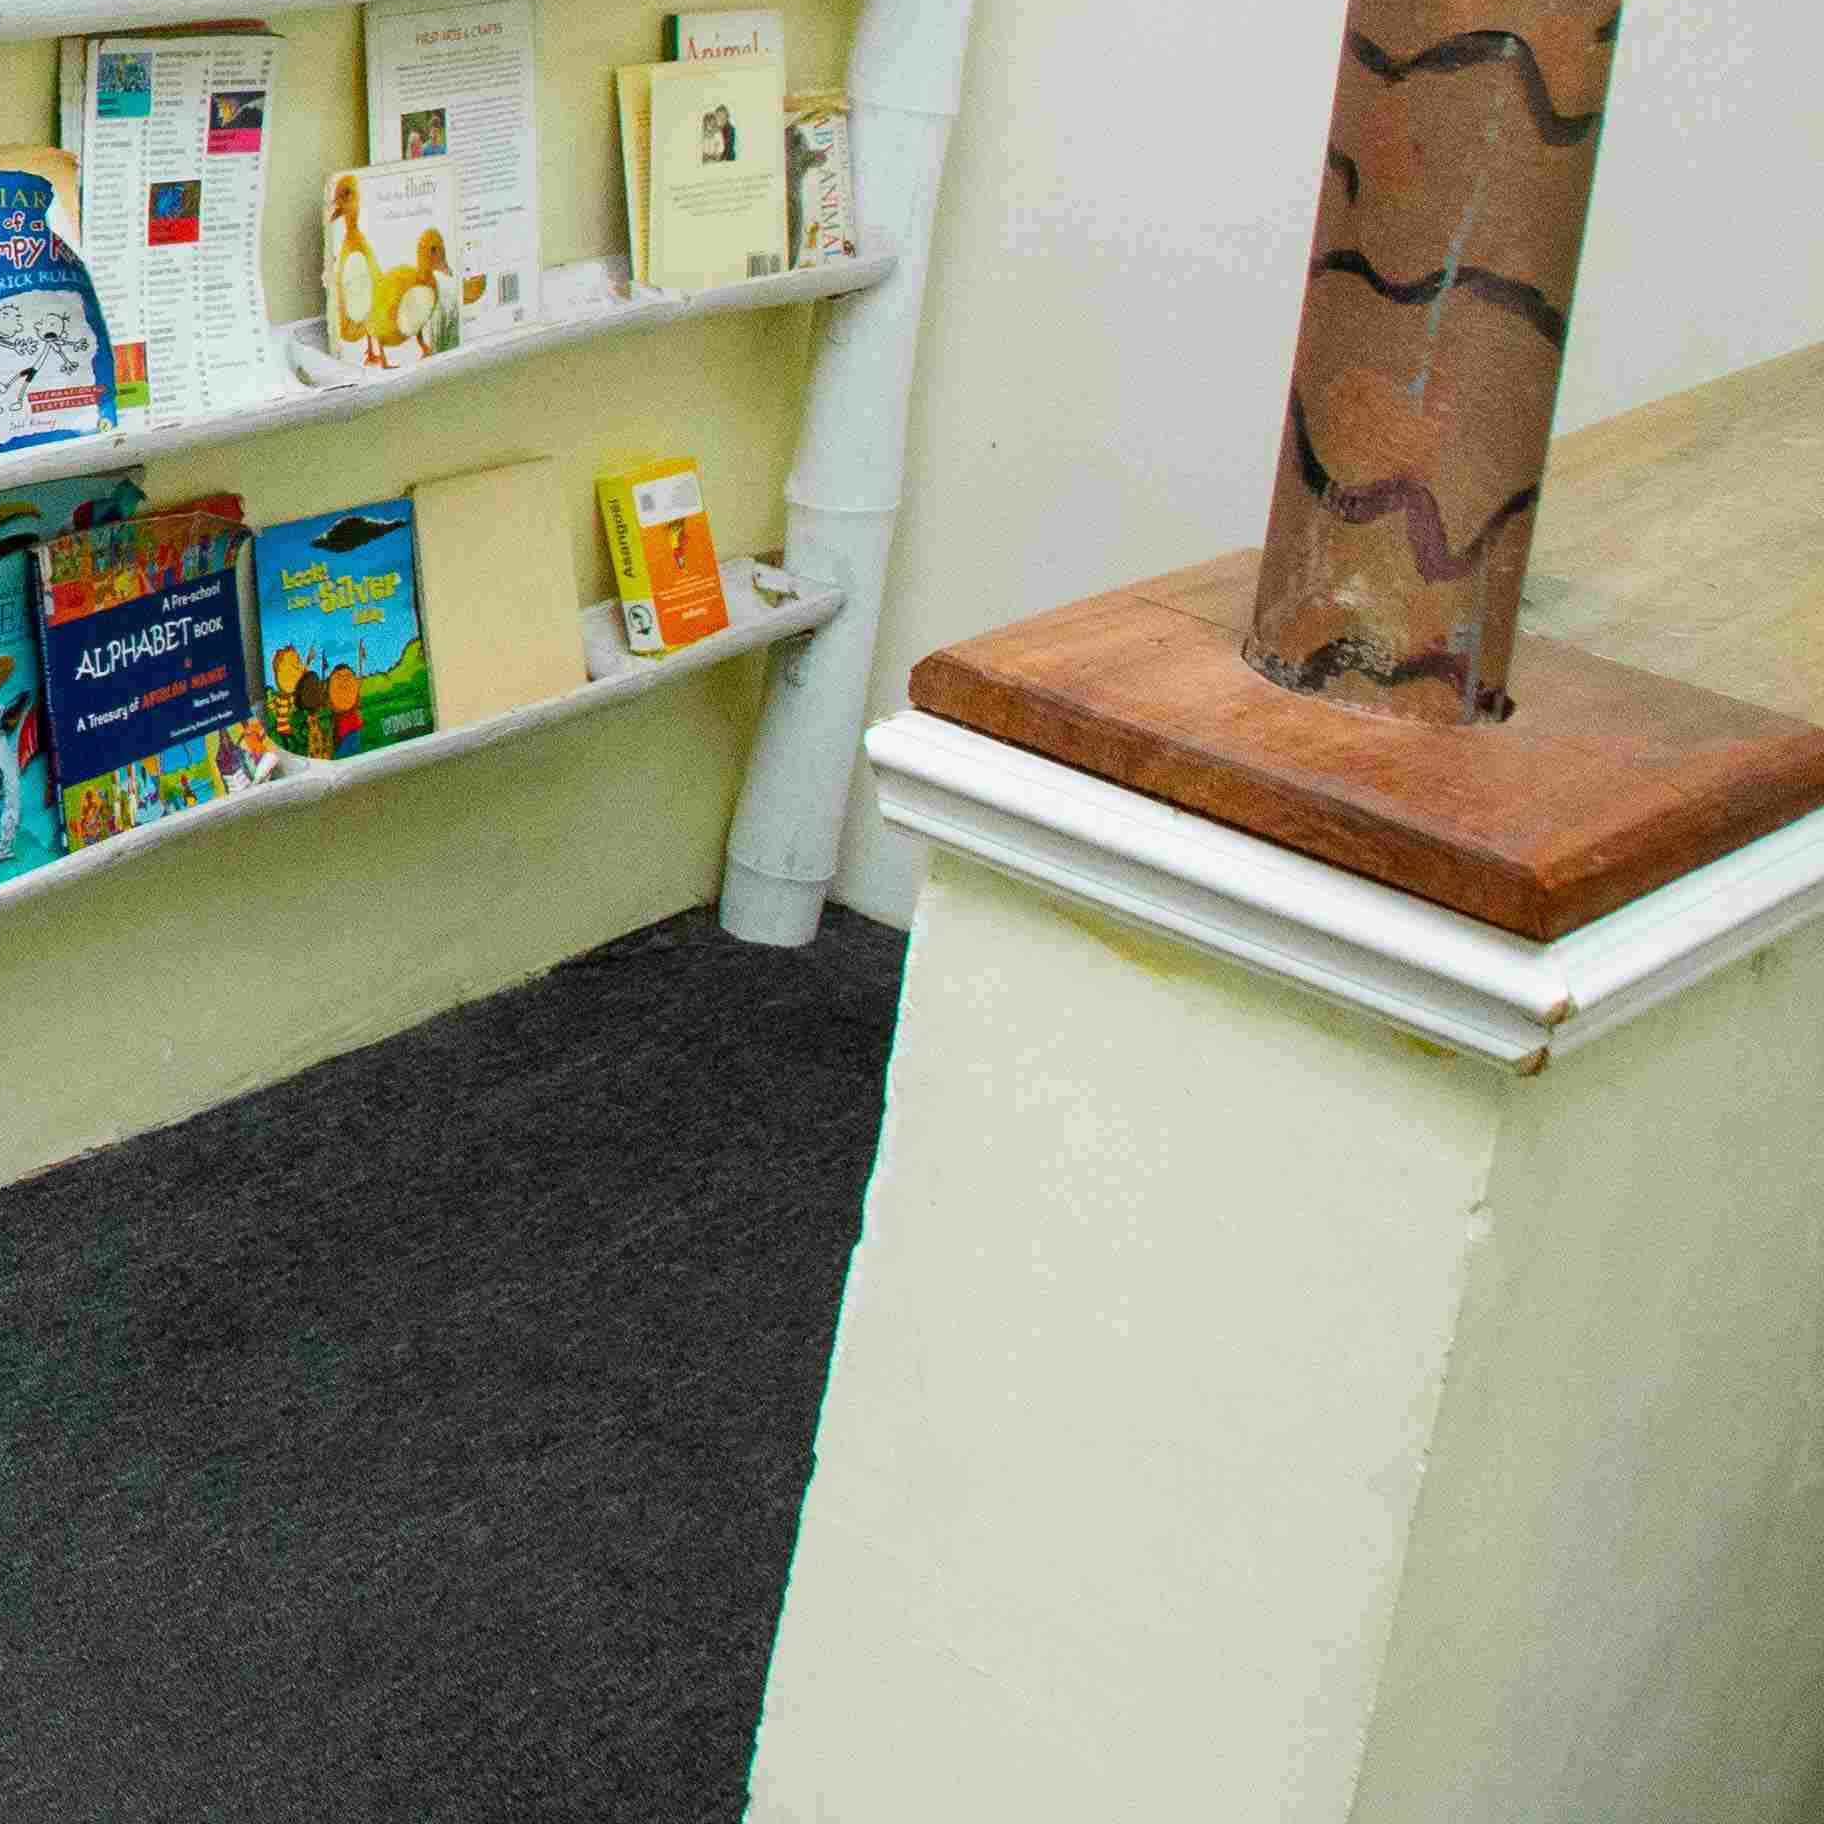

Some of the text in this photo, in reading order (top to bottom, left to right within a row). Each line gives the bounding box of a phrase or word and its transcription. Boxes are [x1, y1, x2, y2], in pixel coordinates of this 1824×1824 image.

[2, 211, 44, 232] of a
[171, 580, 221, 610] Pre-school
[75, 616, 224, 681] ALPHABET BOOK
[76, 697, 140, 733] A Treasury of
